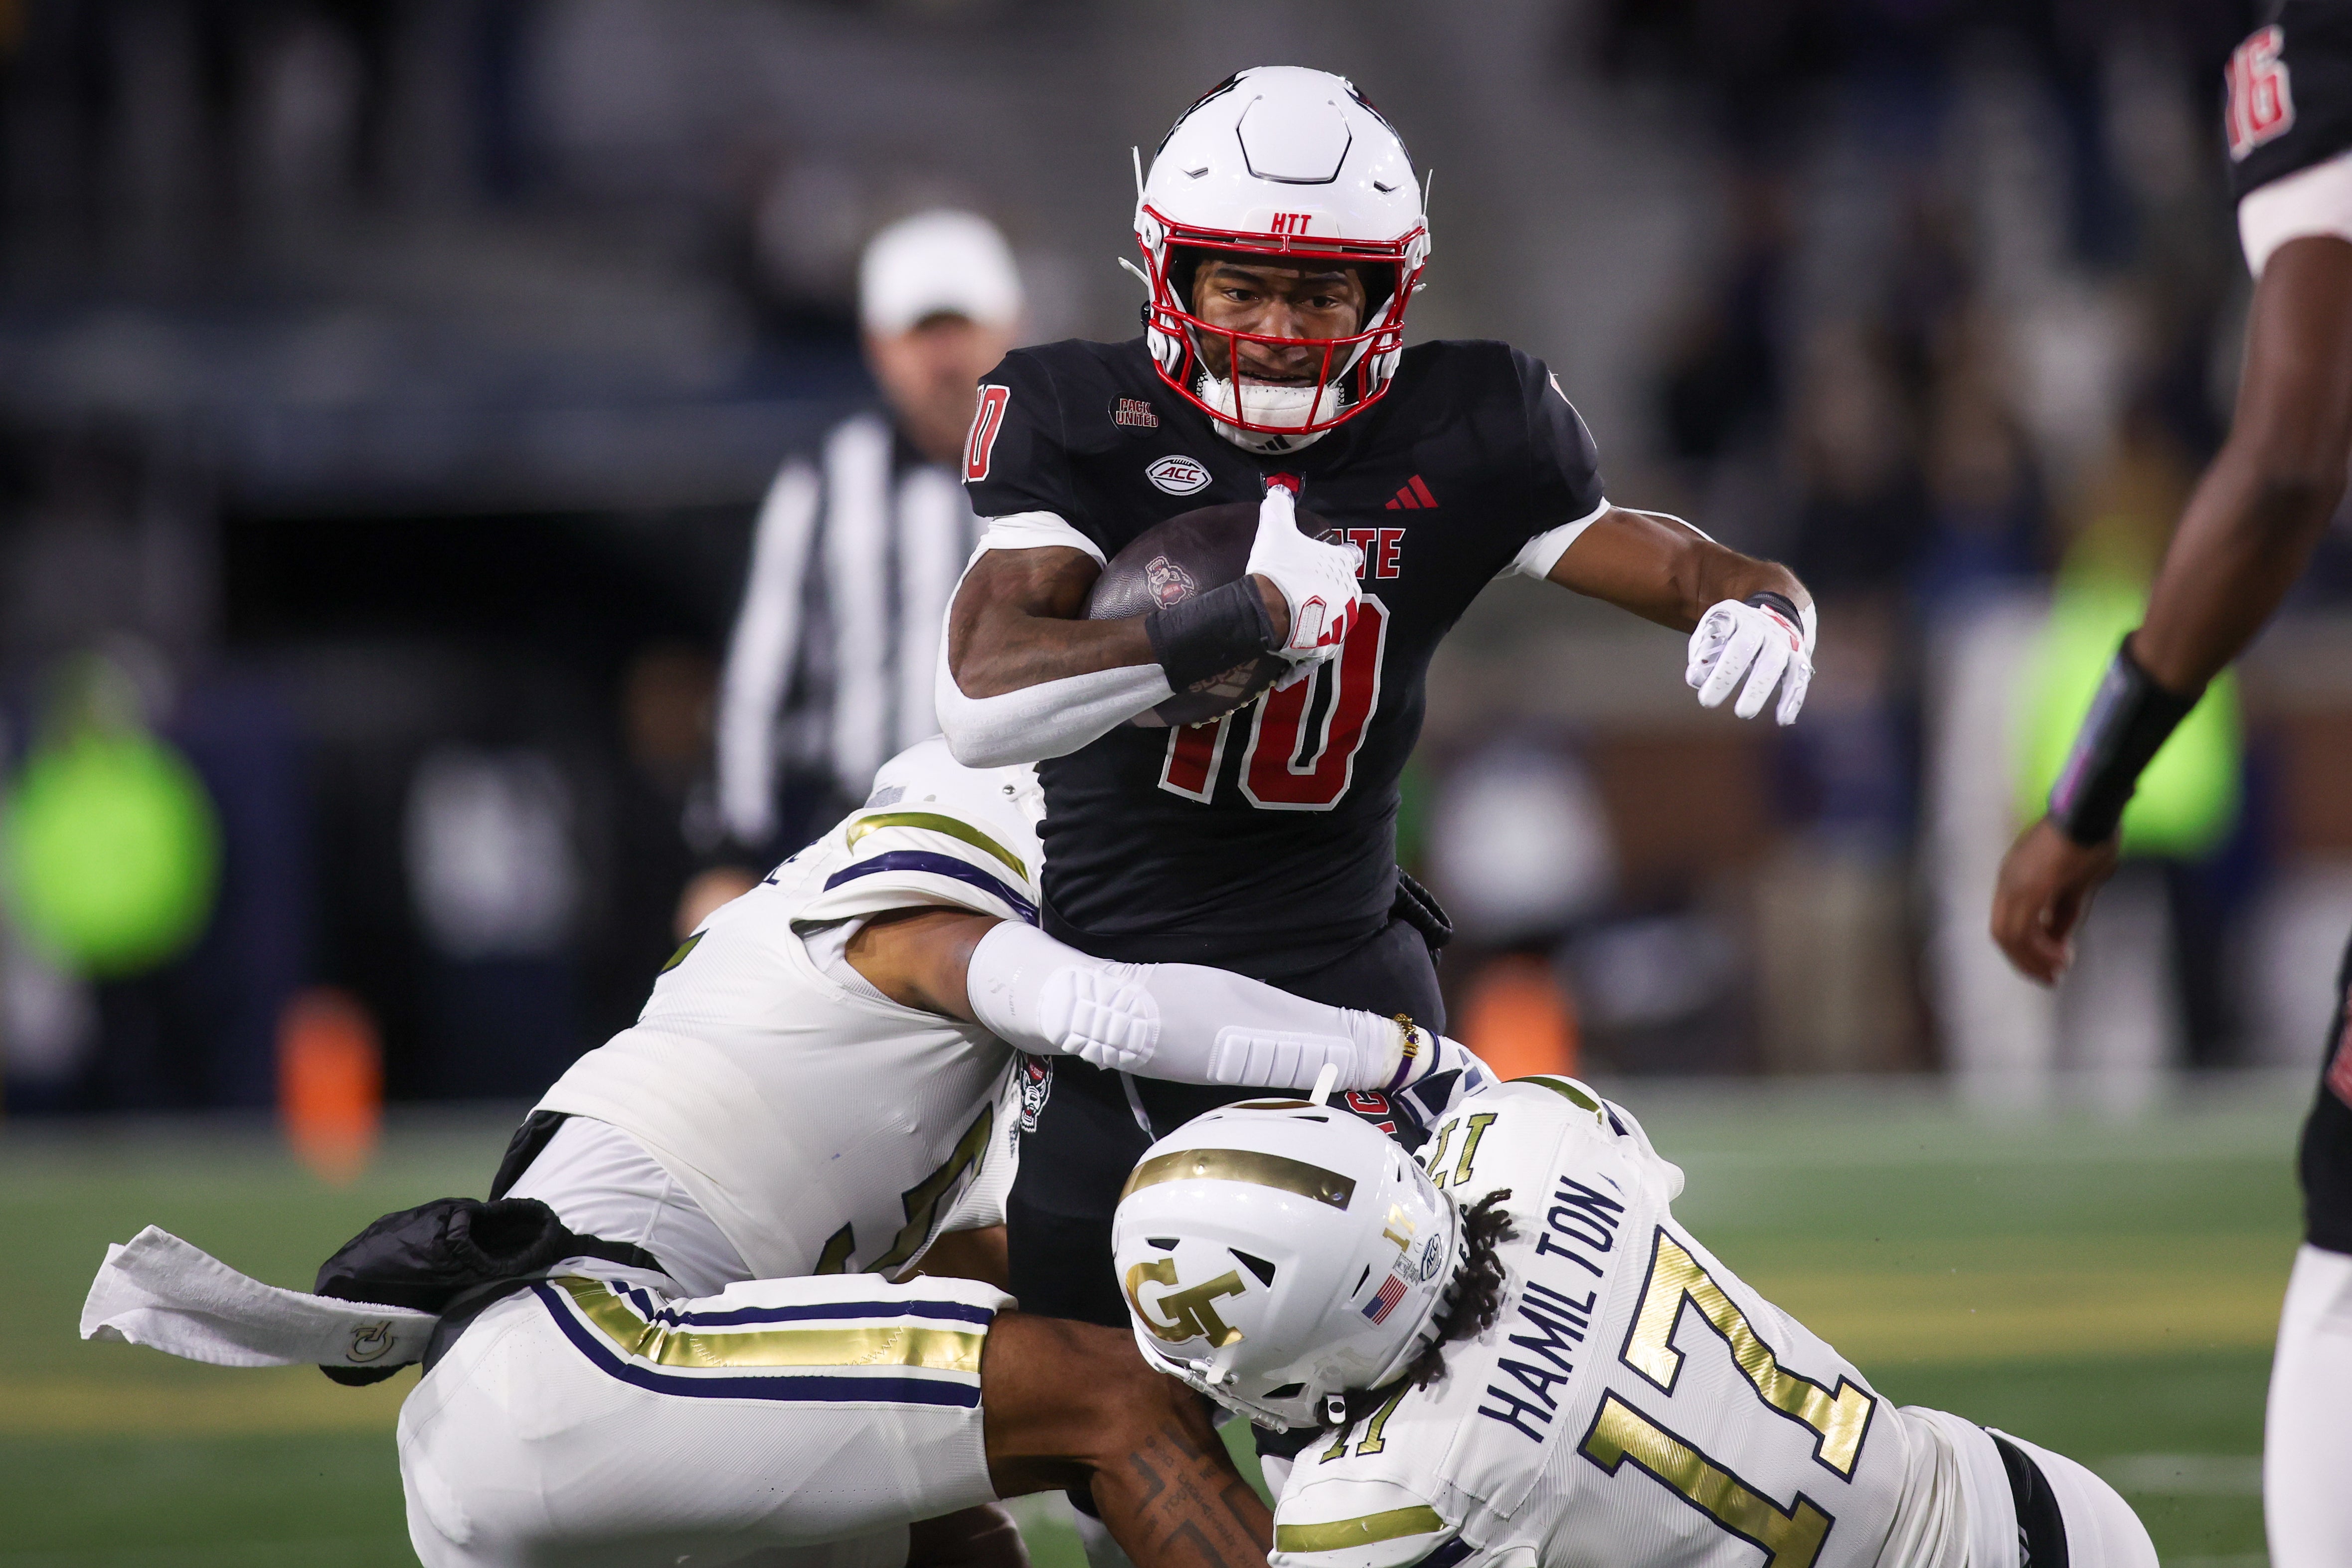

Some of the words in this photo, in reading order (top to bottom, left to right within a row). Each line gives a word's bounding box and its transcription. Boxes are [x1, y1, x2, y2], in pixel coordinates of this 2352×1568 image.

[1271, 212, 1312, 235] HTT
[1116, 411, 1159, 428] UNITED
[1120, 398, 1151, 414] PACK
[1158, 467, 1201, 481] ACC
[1382, 1203, 1416, 1253] 17
[1426, 1237, 1439, 1275] ACC
[1478, 1175, 1627, 1444] HAMILTON
[1577, 1224, 1877, 1568] 17
